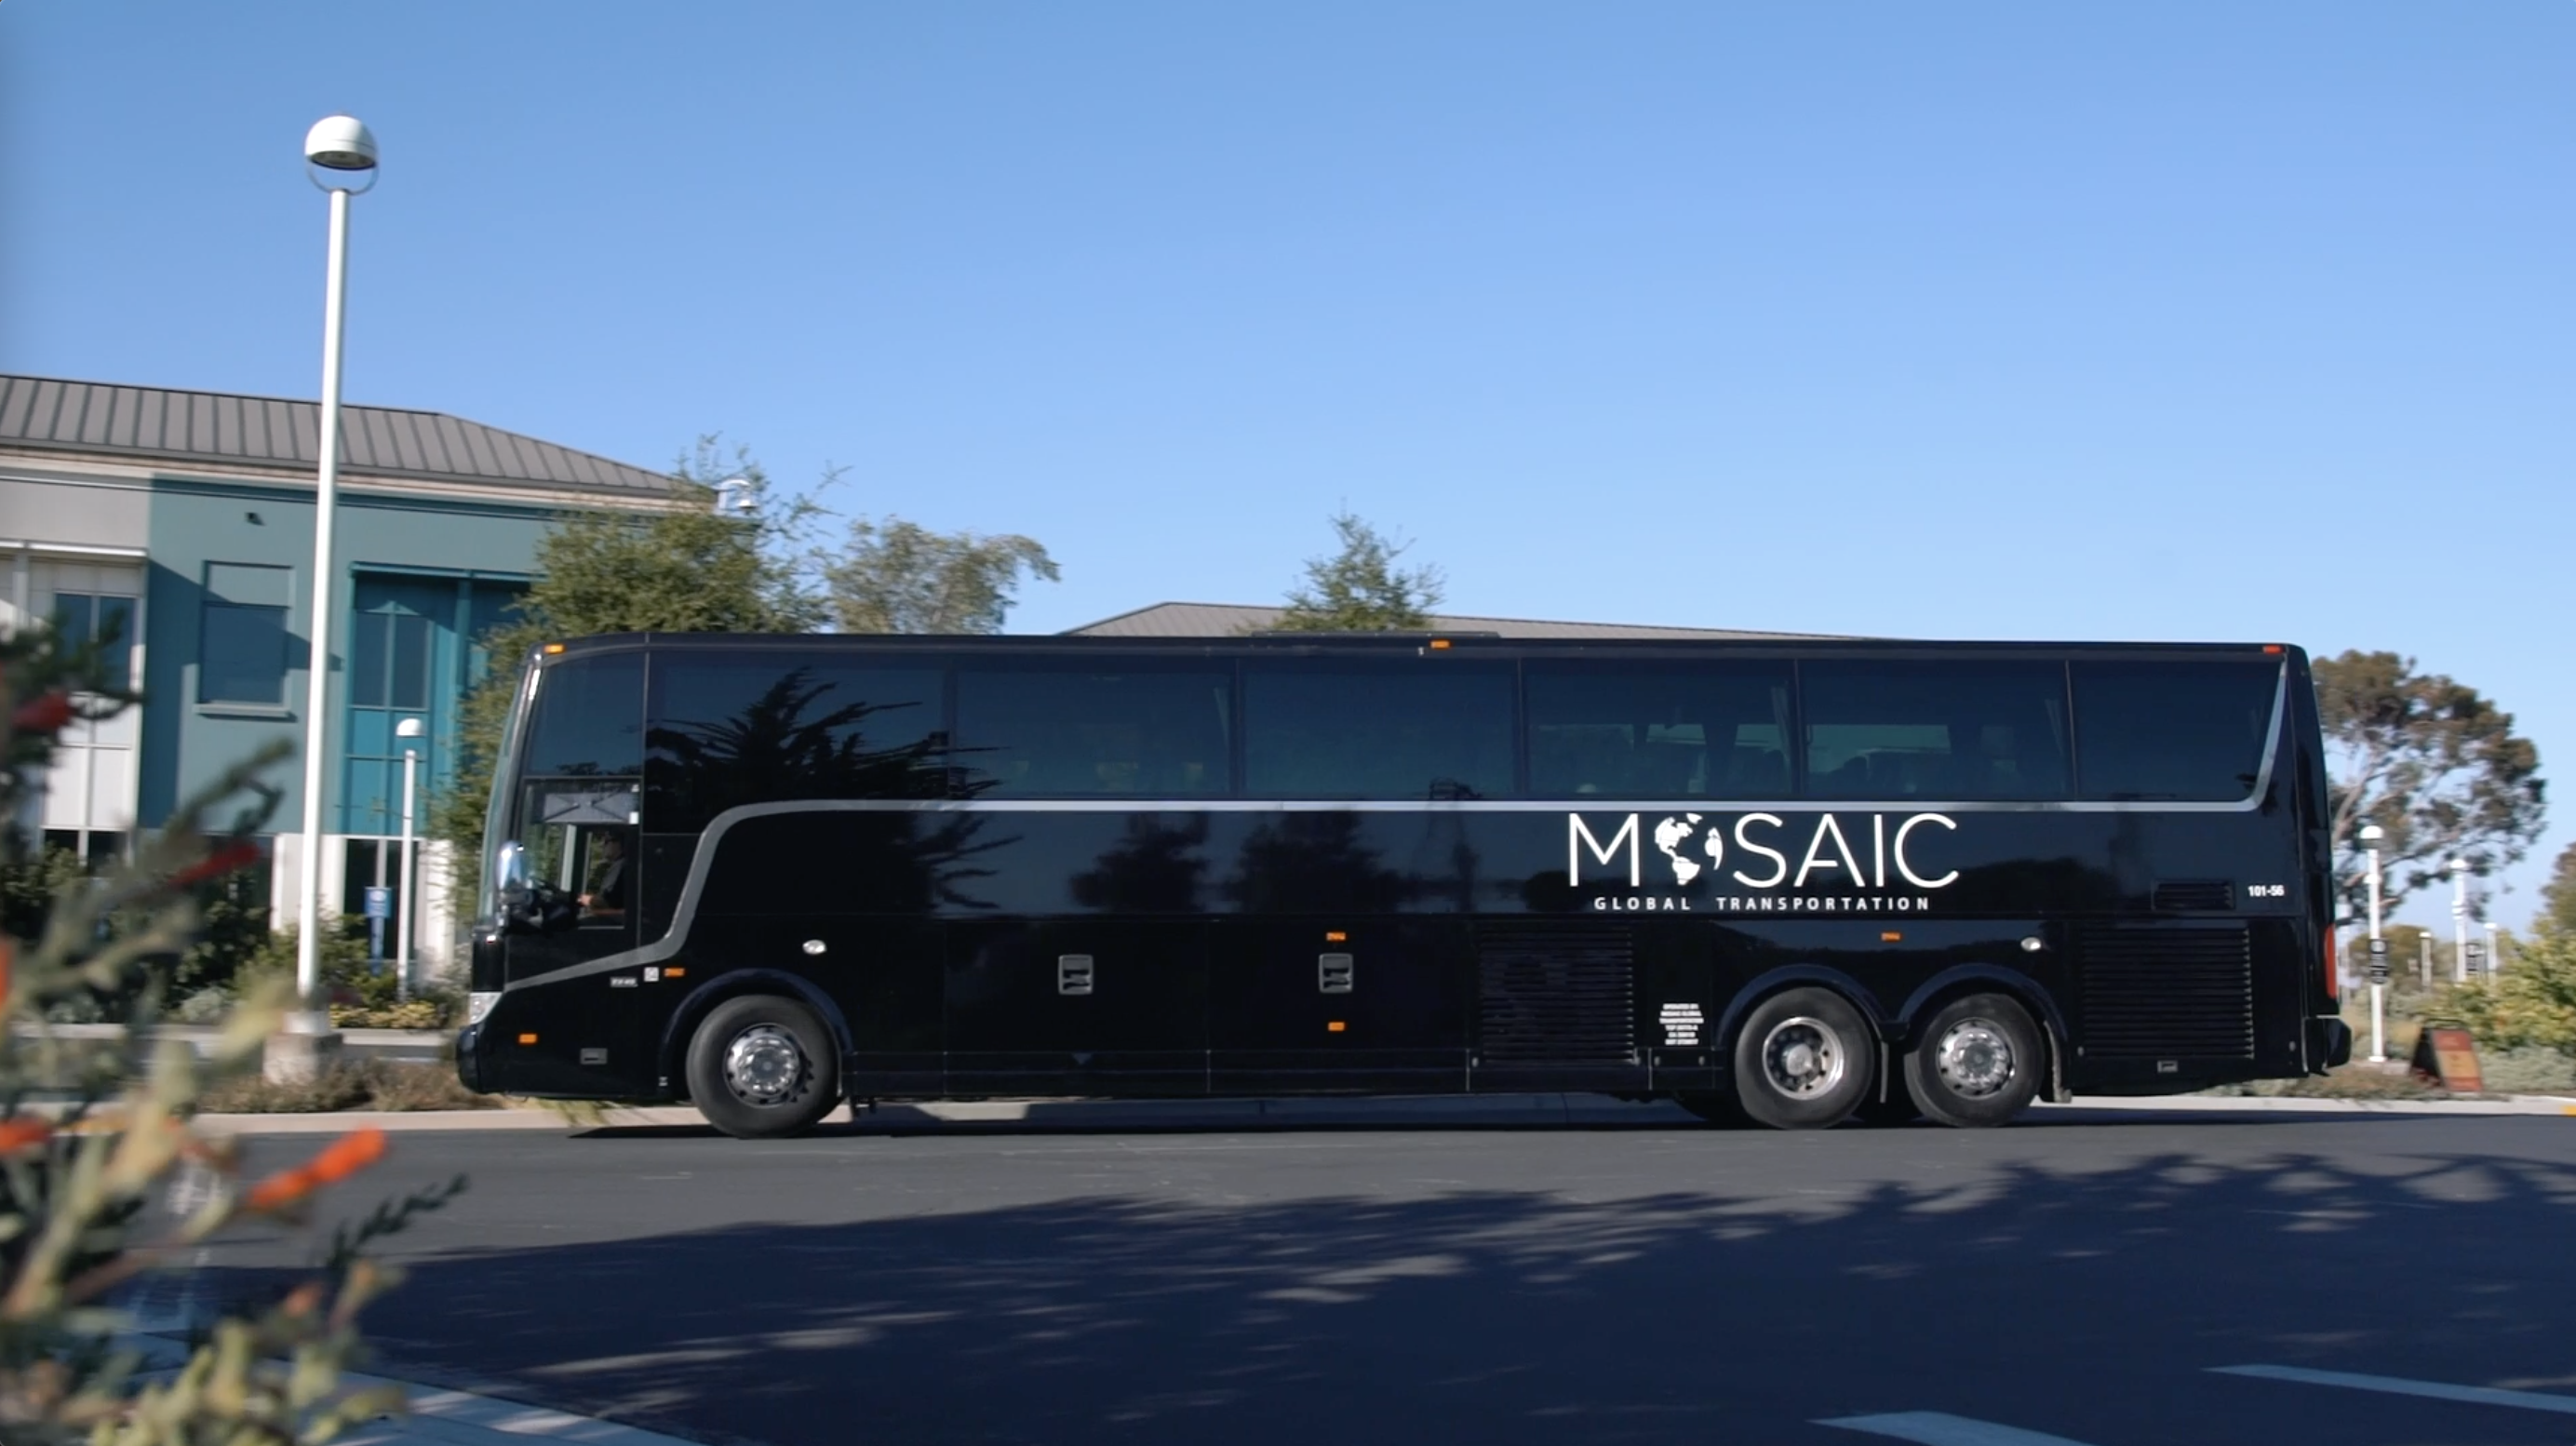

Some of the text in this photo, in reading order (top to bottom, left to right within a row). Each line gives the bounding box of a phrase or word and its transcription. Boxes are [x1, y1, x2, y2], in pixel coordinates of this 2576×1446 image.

[2247, 884, 2285, 897] 101-56
[1593, 896, 1929, 911] GLOBAL TRANSPORTATION
